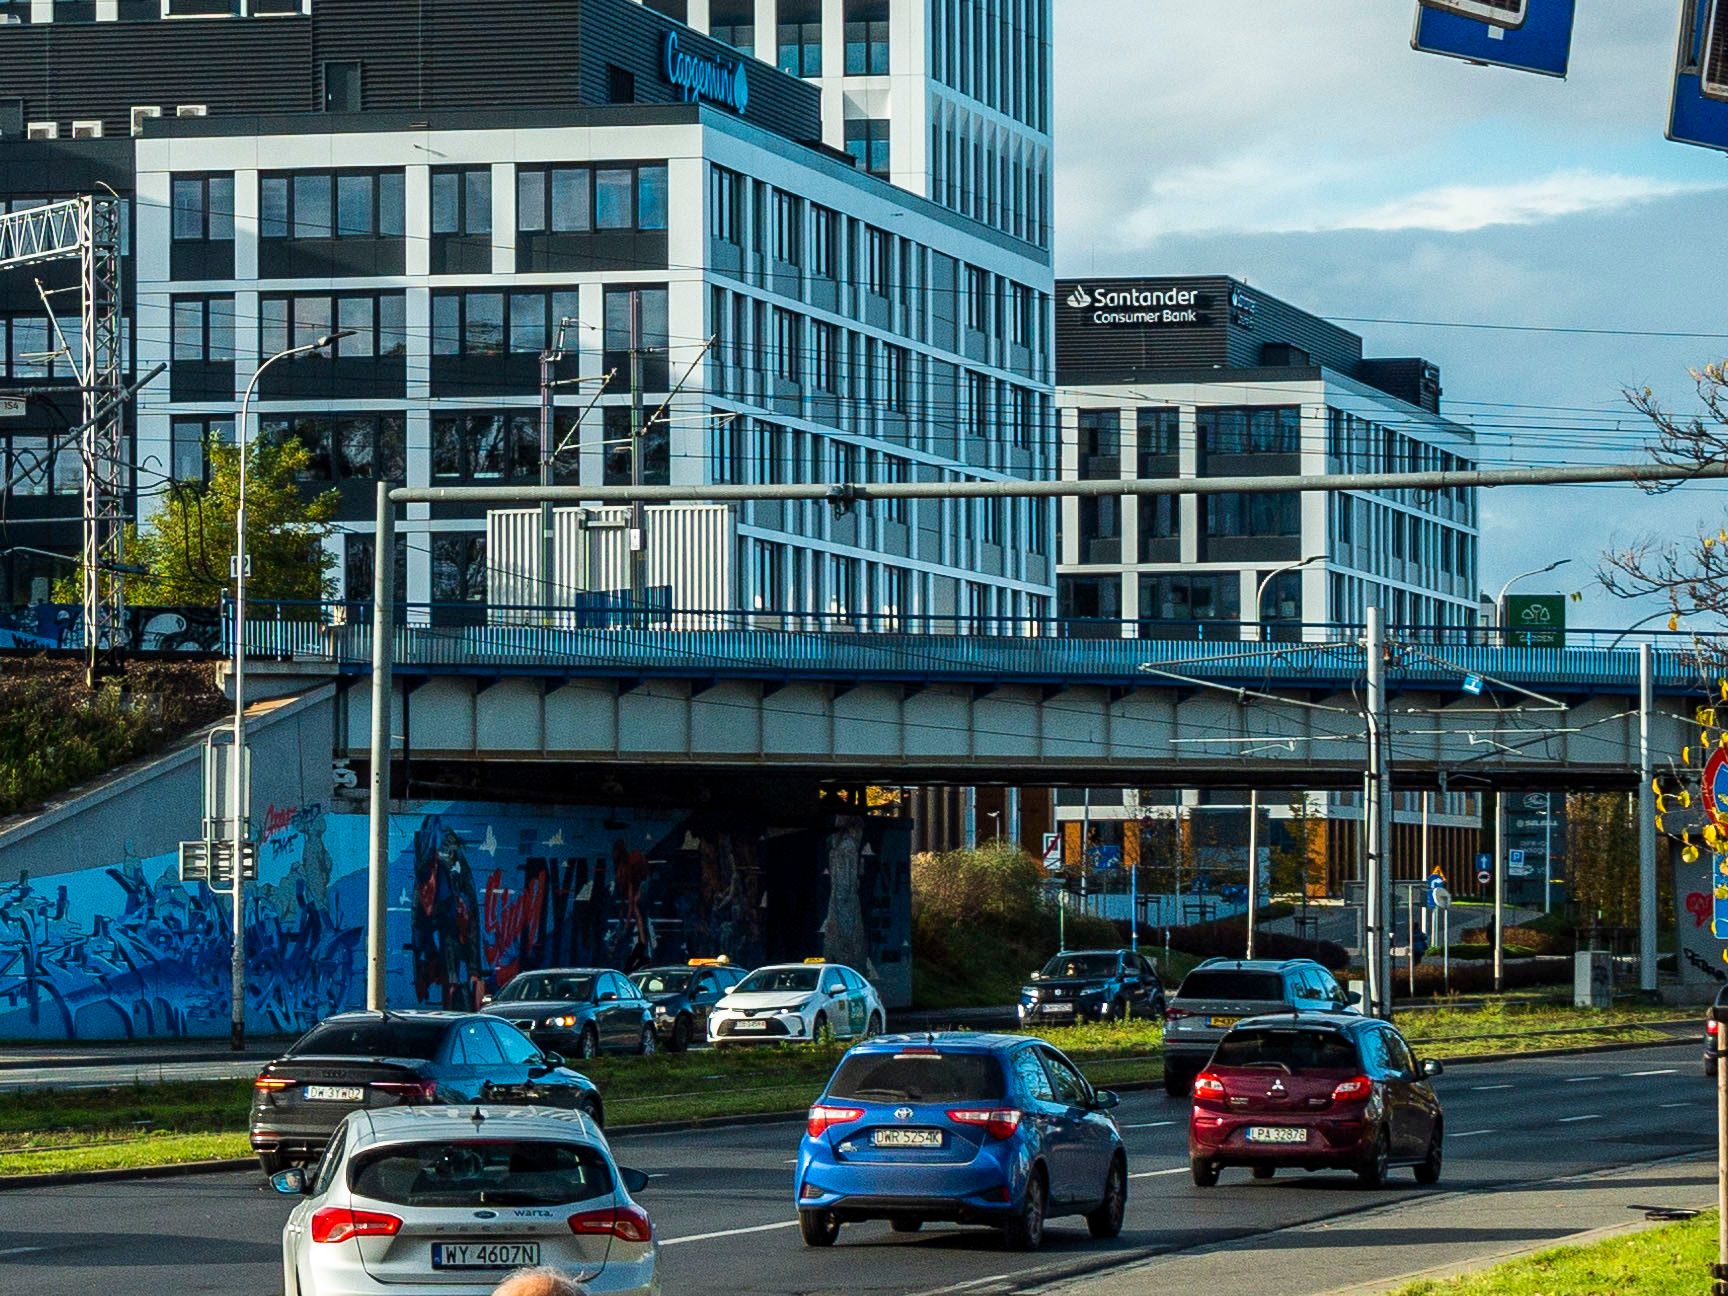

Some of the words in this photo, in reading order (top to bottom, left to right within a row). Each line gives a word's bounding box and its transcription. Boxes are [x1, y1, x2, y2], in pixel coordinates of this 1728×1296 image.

[666, 31, 734, 106] Capgemini
[1094, 288, 1198, 307] Santander
[1093, 311, 1161, 324] Consumer
[1163, 309, 1197, 322] Bank
[876, 1130, 899, 1143] DWR
[904, 1130, 940, 1143] 5254K
[1251, 1128, 1270, 1140] LPA
[446, 1246, 469, 1264] WY
[476, 1245, 534, 1264] 4607N
